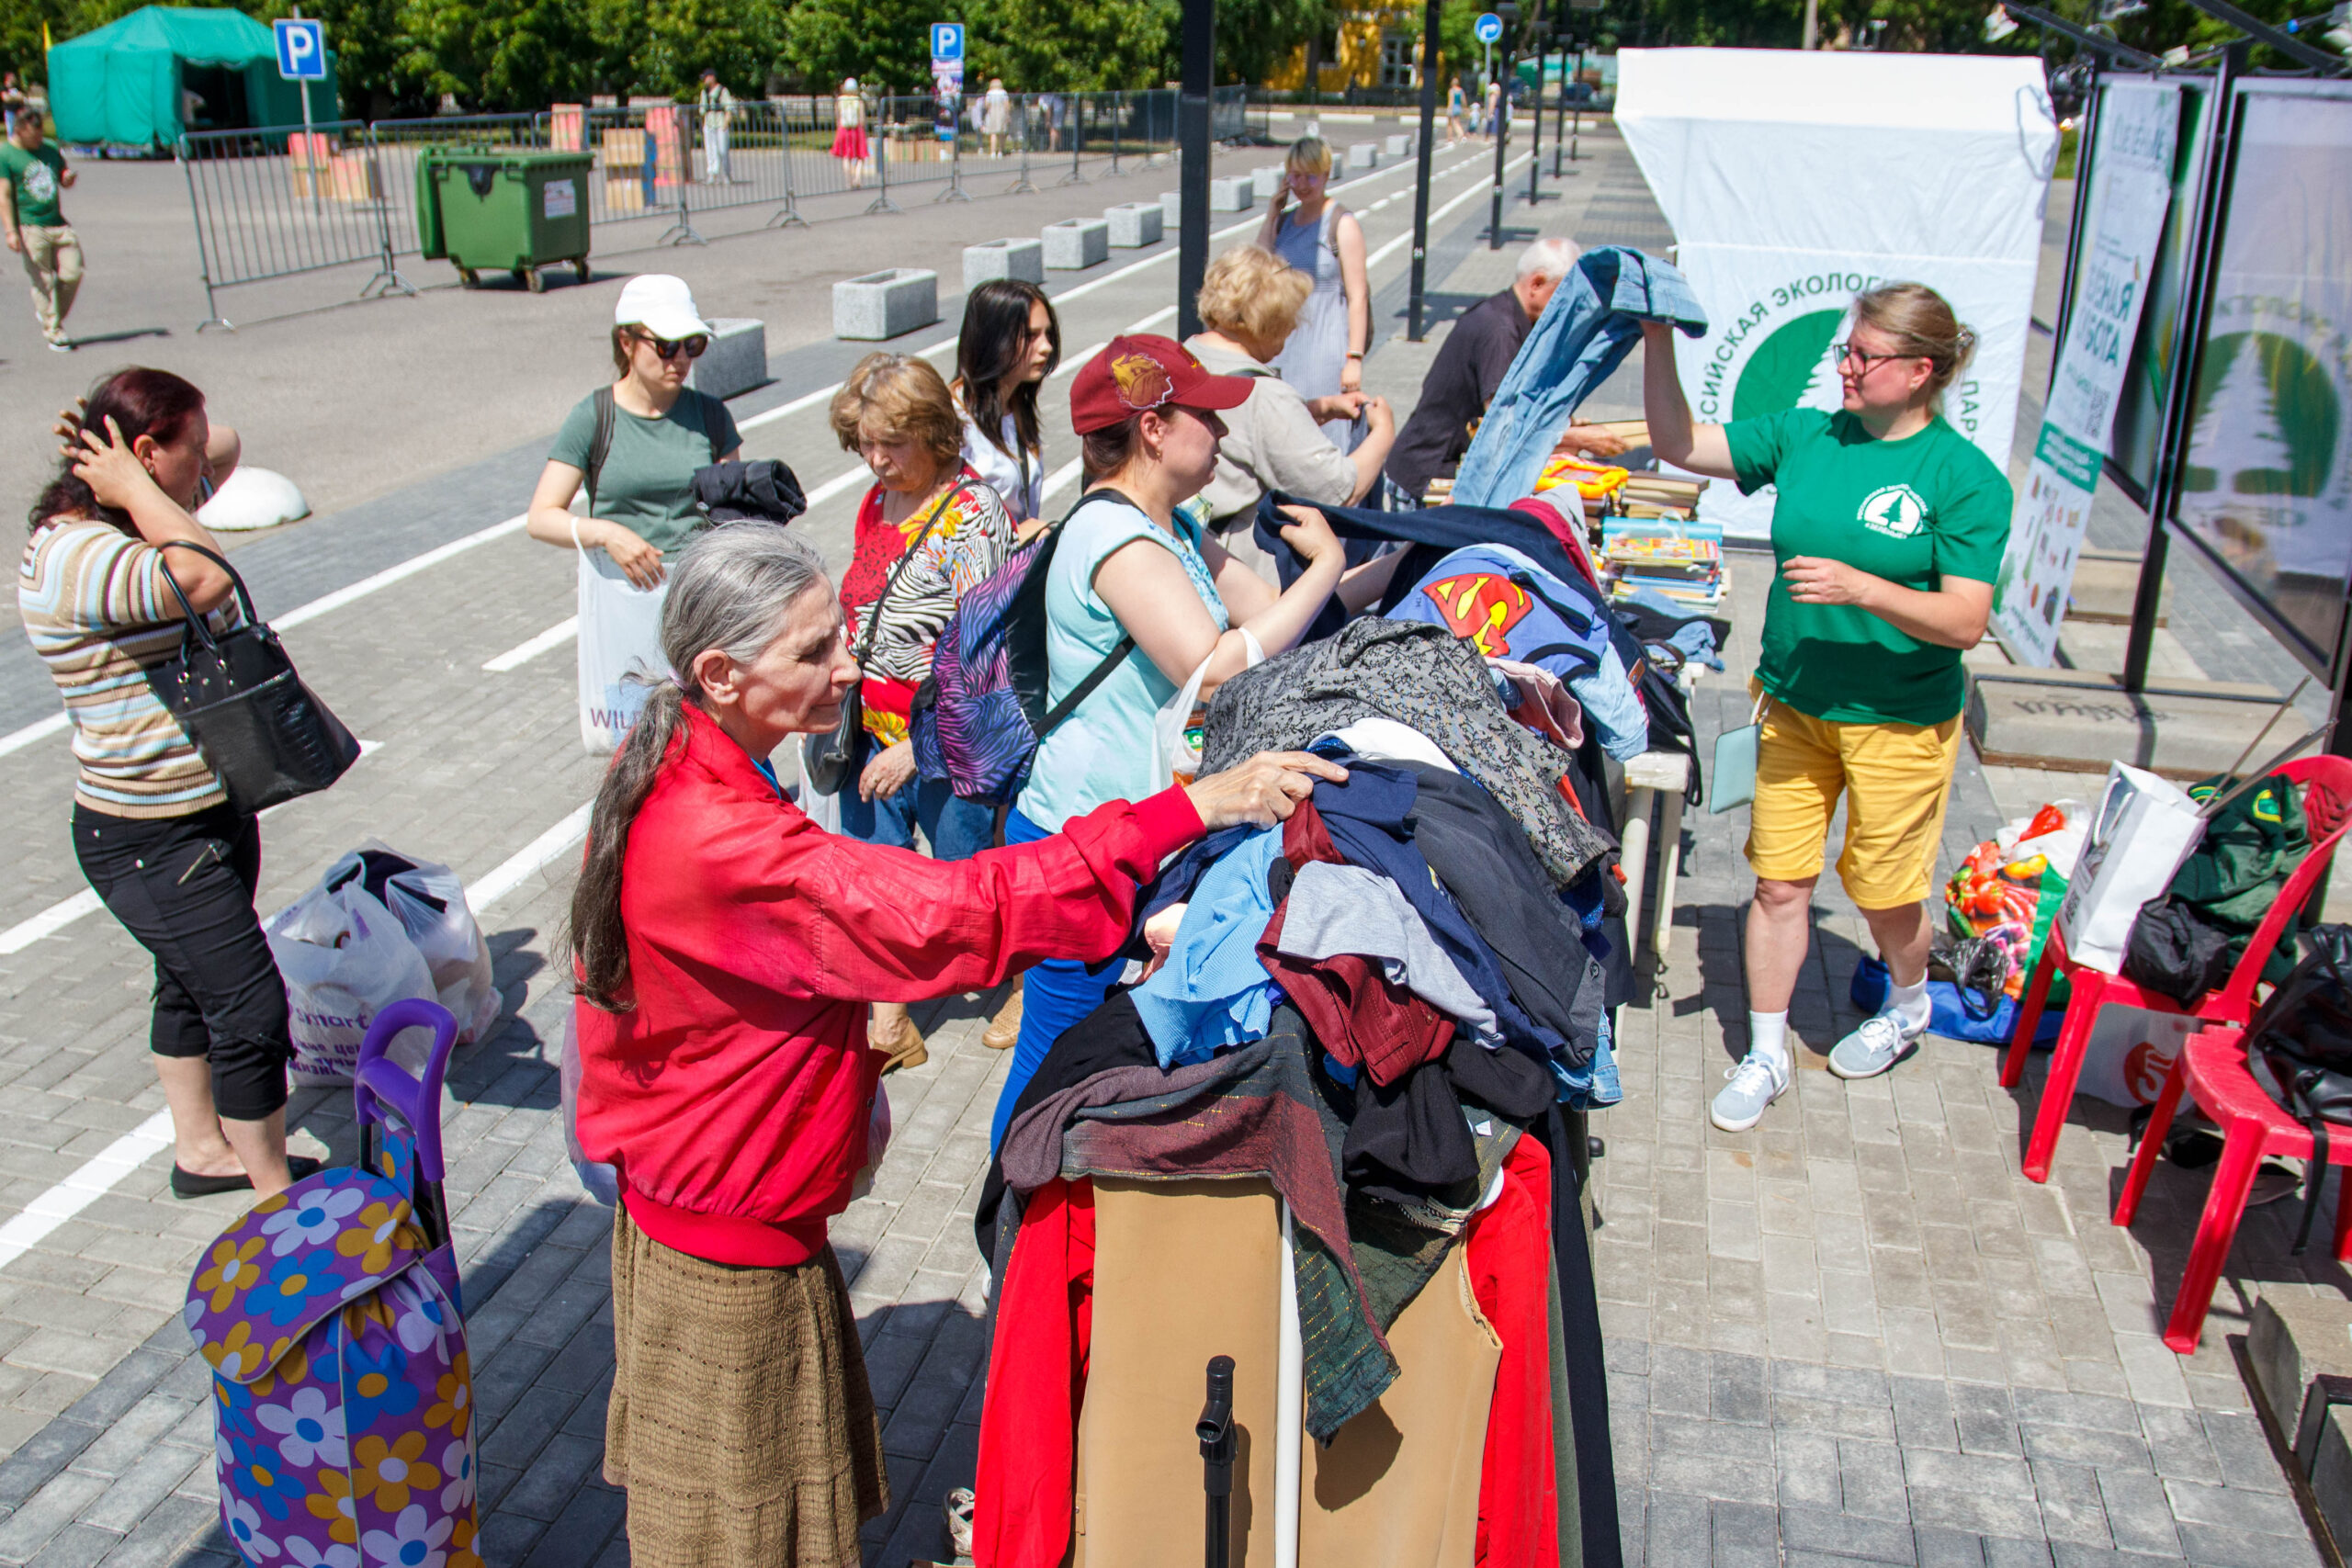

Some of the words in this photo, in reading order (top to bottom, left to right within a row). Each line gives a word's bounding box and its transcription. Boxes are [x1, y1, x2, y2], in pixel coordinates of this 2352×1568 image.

[286, 26, 314, 73] P
[938, 27, 957, 54] P
[1700, 300, 1770, 424] СИЙСКАЯ
[1771, 273, 1886, 307] ЭКОЛОГ
[1961, 380, 1979, 441] ПАР
